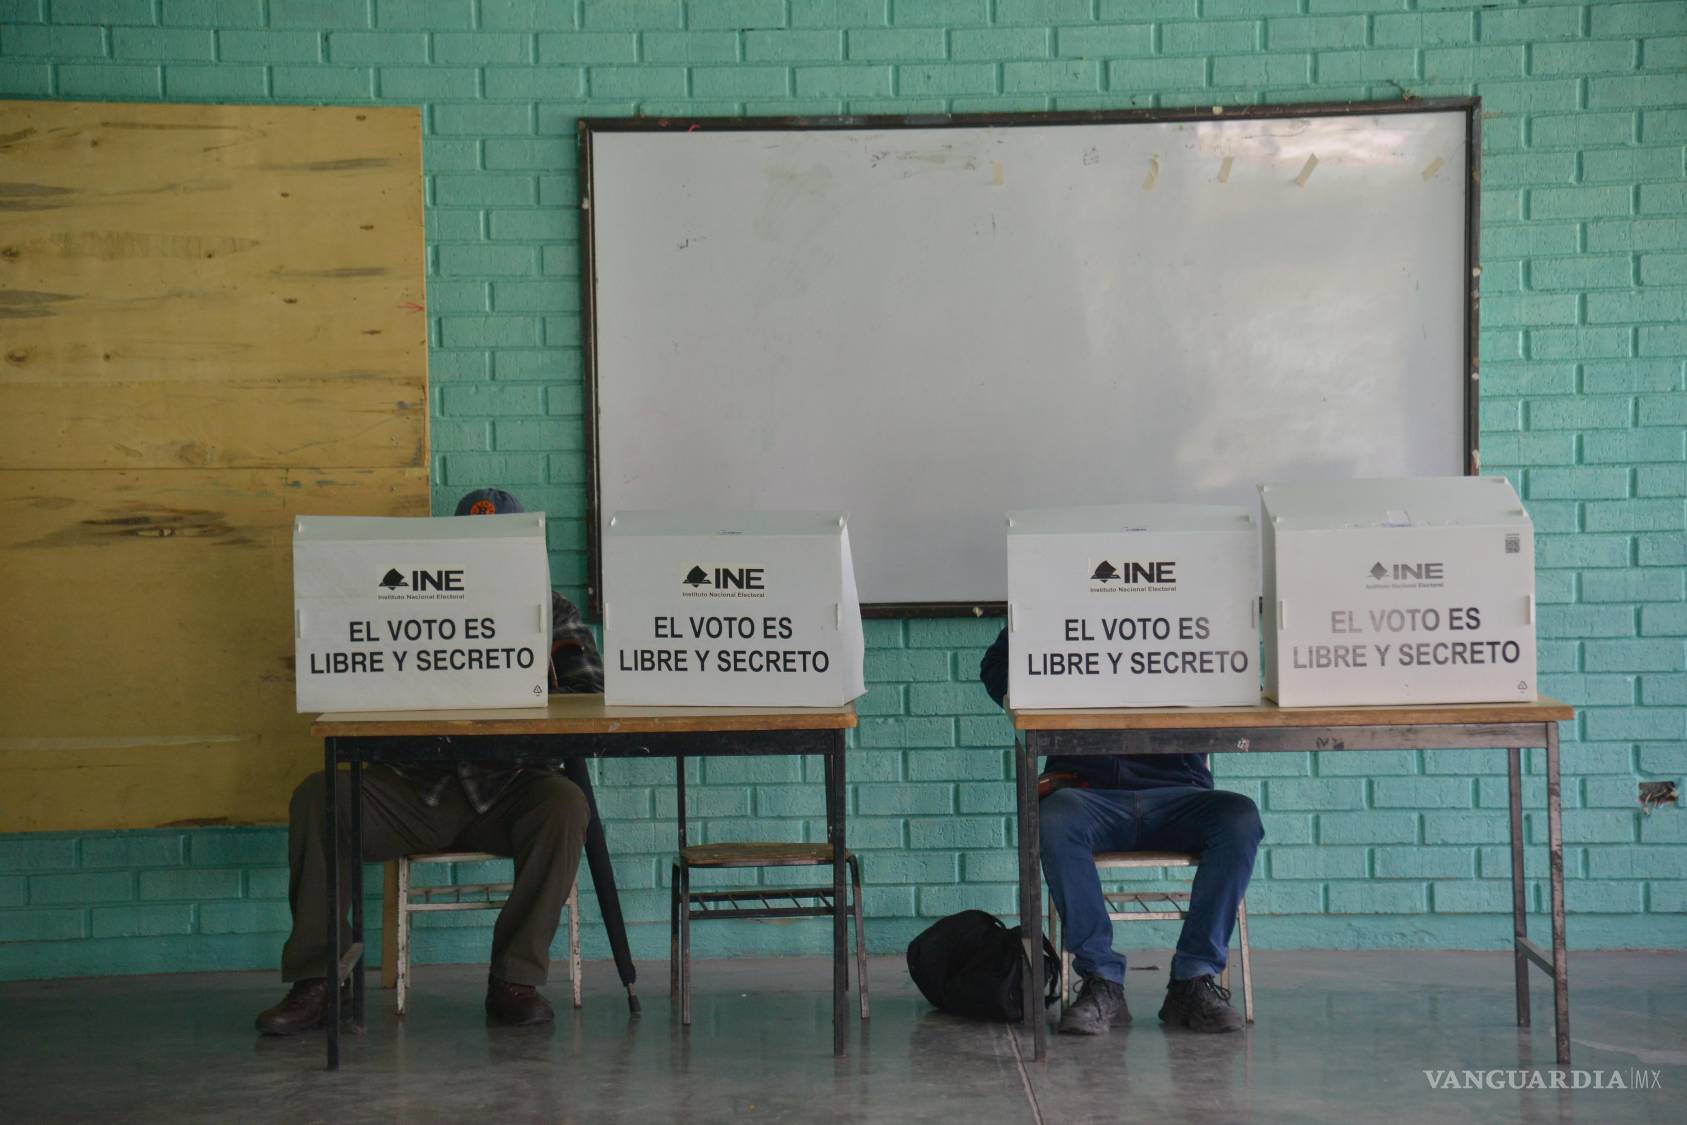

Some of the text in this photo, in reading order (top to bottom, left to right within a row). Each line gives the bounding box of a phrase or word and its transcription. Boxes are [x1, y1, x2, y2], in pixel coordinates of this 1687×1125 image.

[412, 569, 465, 592] INE
[714, 567, 766, 590] INE
[1122, 561, 1177, 585] INE
[1393, 562, 1444, 581] INE
[348, 617, 497, 644] EL VOTO ES
[654, 615, 793, 641] EL VOTO ES
[1065, 616, 1211, 642] EL VOTO ES
[1332, 606, 1482, 634] EL VOTO ES
[309, 646, 536, 675] LIBRE Y SECRETO
[620, 648, 830, 674] LIBRE Y SECRETO
[1027, 650, 1249, 677] LIBRE Y SECRETO
[1294, 639, 1521, 669] LIBRE Y SECRETO
